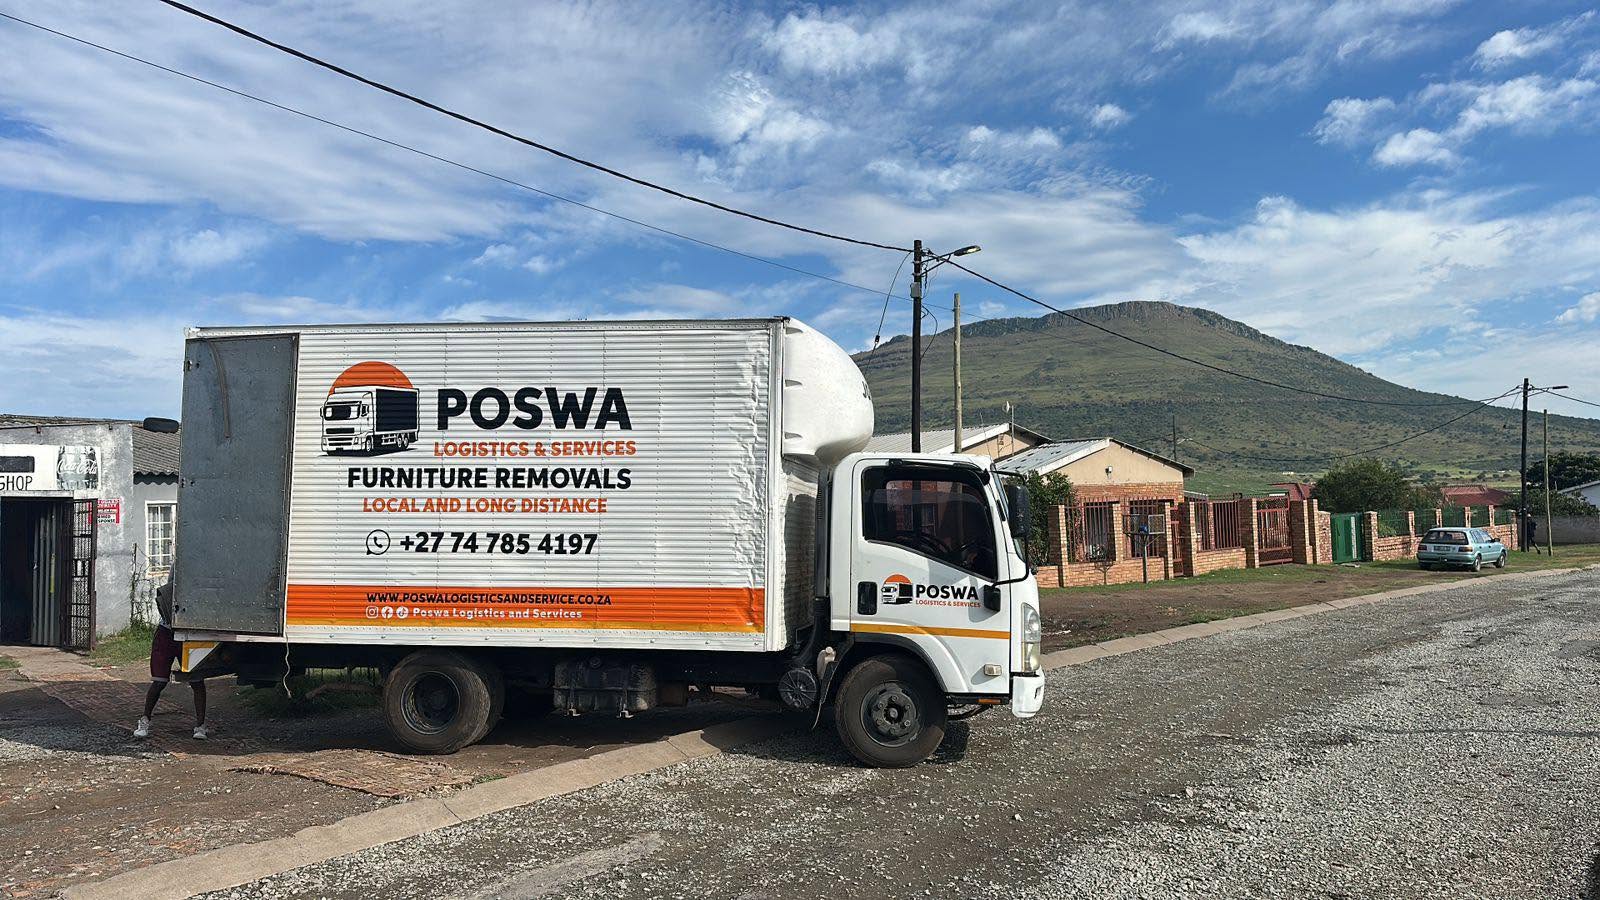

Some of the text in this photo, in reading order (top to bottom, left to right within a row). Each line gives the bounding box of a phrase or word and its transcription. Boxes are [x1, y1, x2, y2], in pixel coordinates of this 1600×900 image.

[437, 387, 632, 430] POSWA
[434, 440, 636, 457] LOGISTICS & SERVICES
[347, 467, 632, 489] FURNITURE REMOVALS
[363, 497, 608, 513] LOCAL AND LONG DISTANCE
[400, 532, 598, 555] +27 74 785 4197
[366, 592, 612, 606] WWW.POSWALOGISTICSANDSERVICE.CO.ZA
[916, 584, 979, 600] POSWA
[915, 599, 946, 607] LOGISTICS
[412, 607, 582, 619] Poswa Logistics and Services
